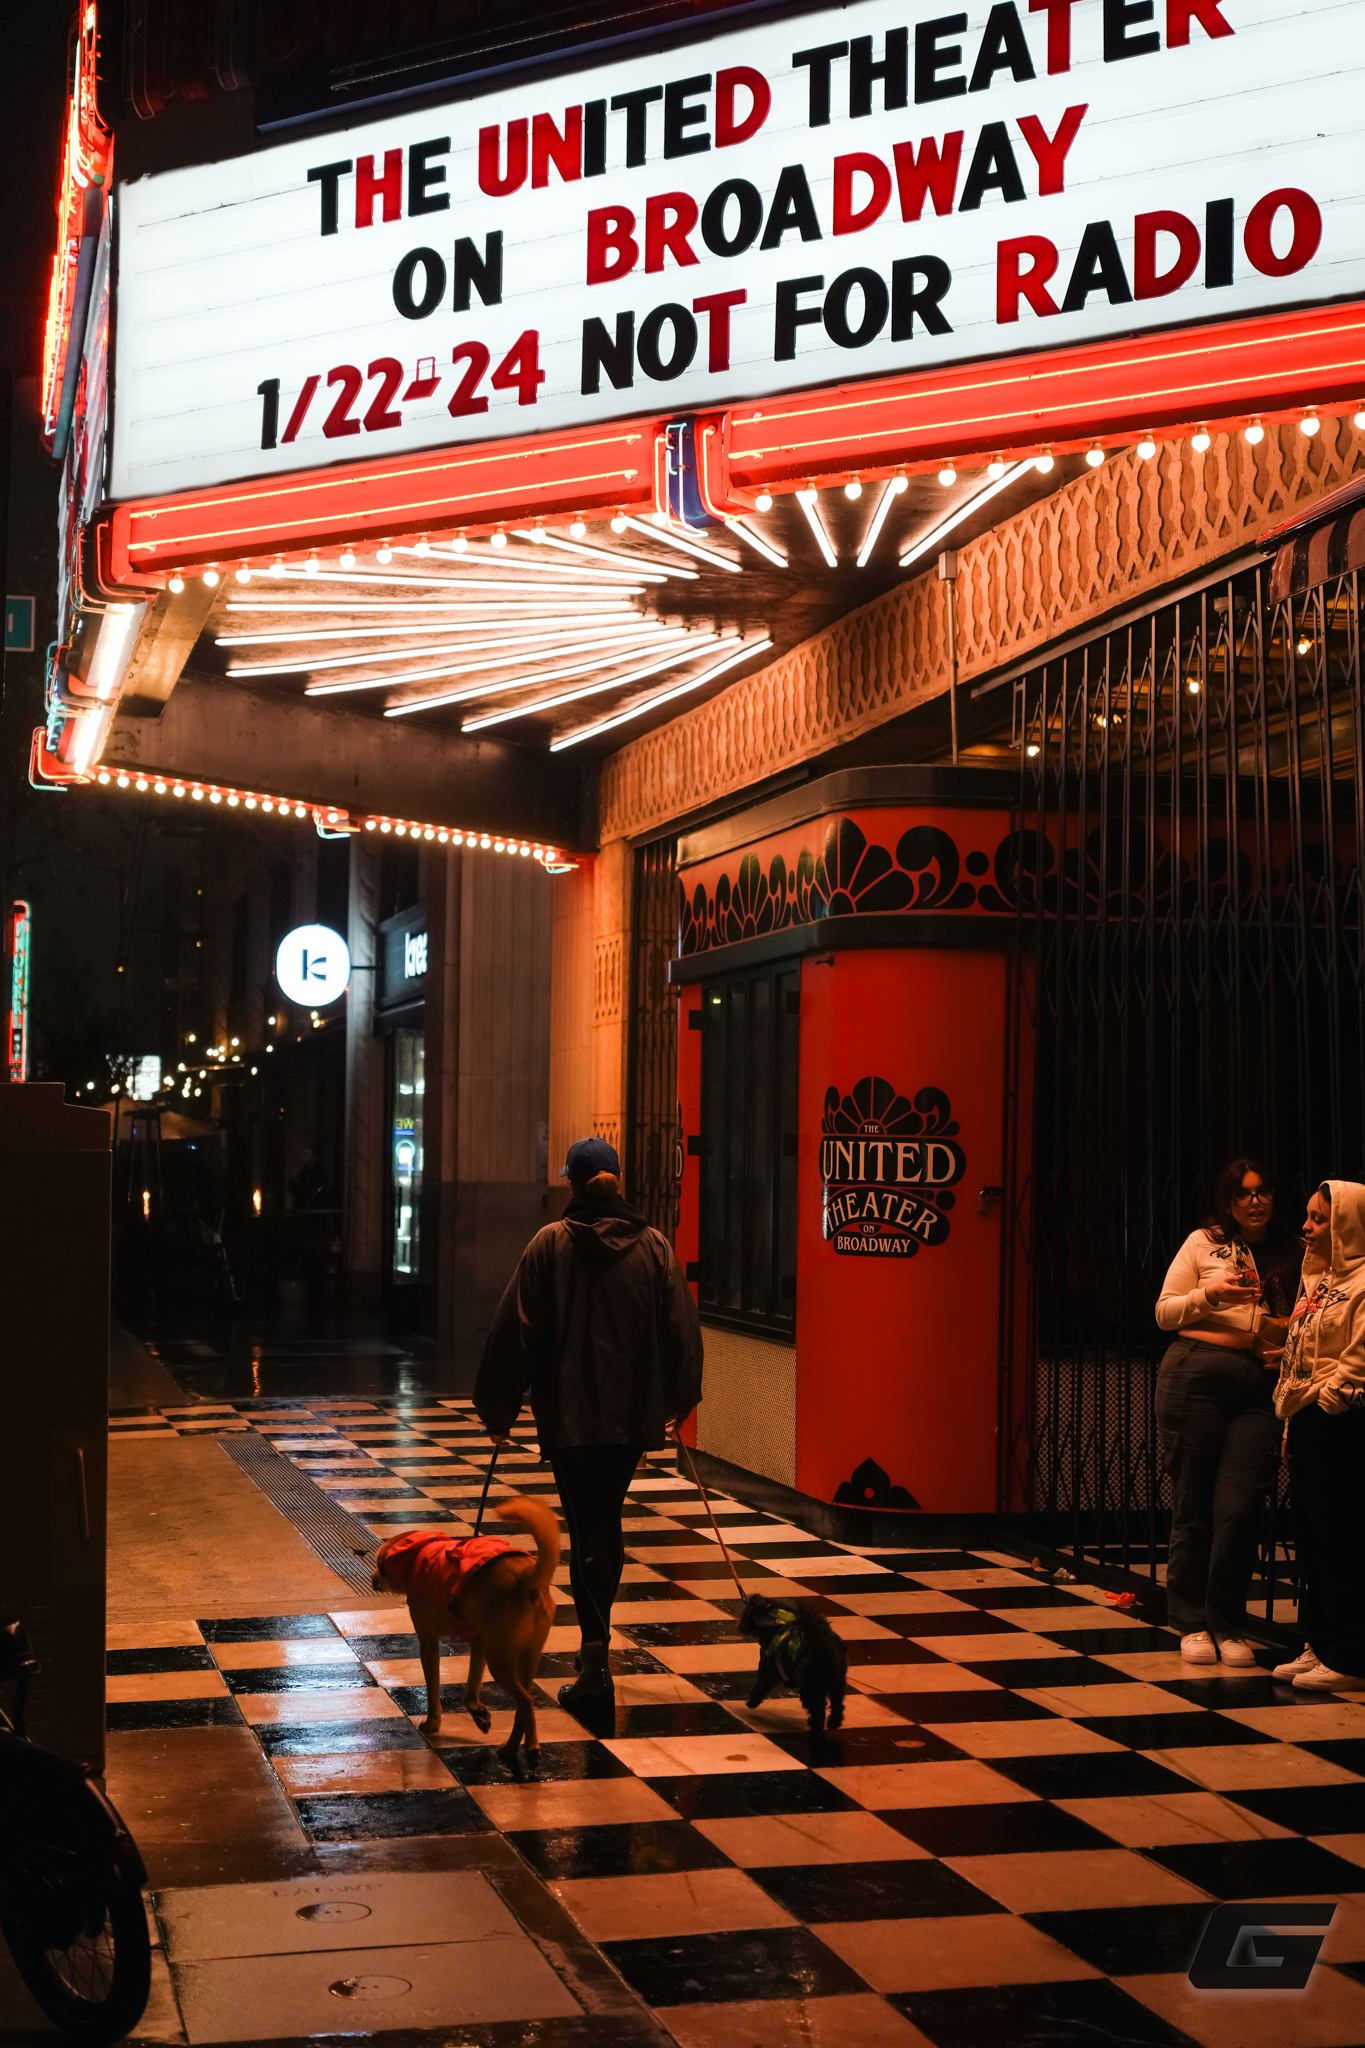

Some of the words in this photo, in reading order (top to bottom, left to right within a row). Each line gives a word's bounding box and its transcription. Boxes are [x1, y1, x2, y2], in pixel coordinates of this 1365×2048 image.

[307, 137, 451, 237] THE
[479, 66, 772, 198] UNITED
[792, 0, 1236, 129] THEATER
[393, 230, 503, 320] ON
[586, 103, 1089, 287] BROADWAY
[257, 330, 546, 450] 1/22-24
[580, 289, 747, 395] NOT
[774, 255, 955, 362] FOR
[996, 188, 1322, 324] RADIO
[864, 1125, 880, 1134] THE
[823, 1141, 956, 1183] UNITED
[826, 1191, 938, 1240] THEATER
[863, 1225, 875, 1234] ON
[837, 1236, 911, 1253] BROADWAY
